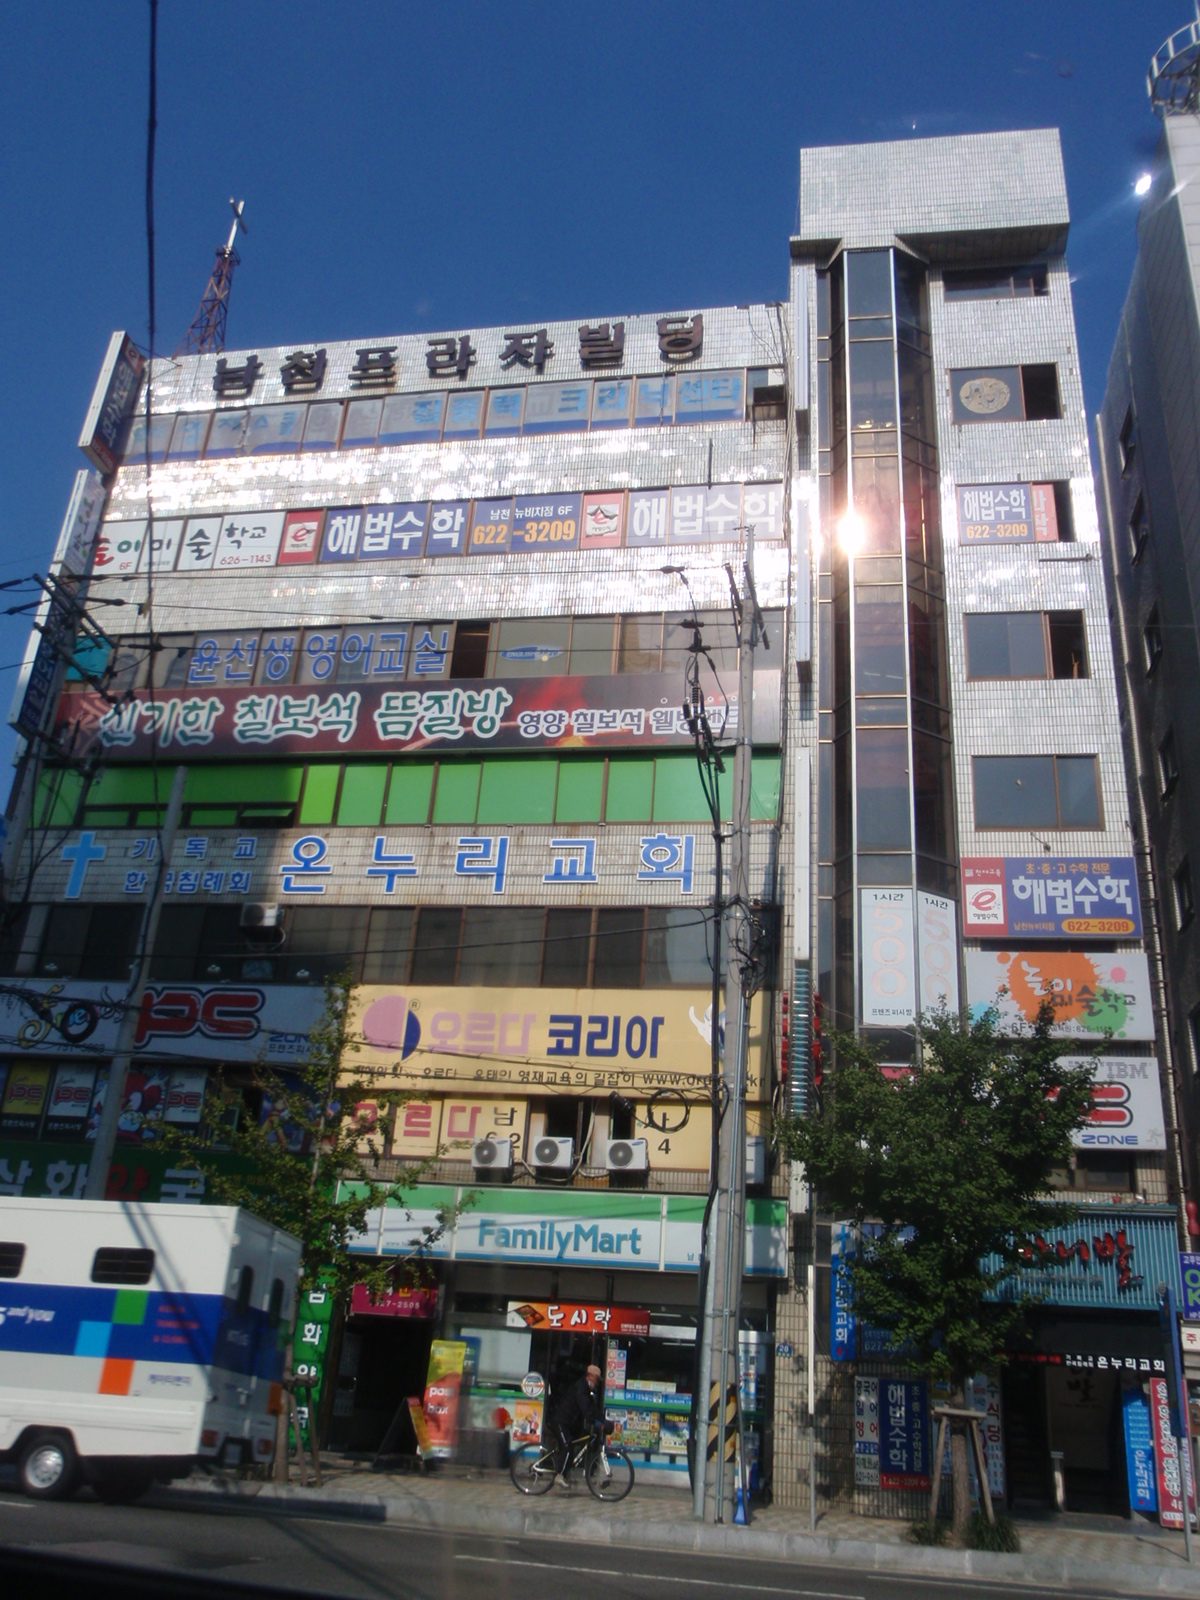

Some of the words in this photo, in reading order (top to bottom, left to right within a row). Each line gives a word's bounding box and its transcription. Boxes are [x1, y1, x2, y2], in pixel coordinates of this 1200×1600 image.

[213, 313, 704, 401] 남천프라자빌딩
[490, 508, 511, 521] 남천
[515, 505, 554, 519] 뉴비치점
[558, 505, 573, 516] 6F
[632, 491, 779, 540] 해법수학
[963, 489, 1026, 521] 해법수학
[327, 507, 465, 556] 해법수학
[473, 519, 576, 545] 622-3209
[966, 523, 1028, 539] 622-3209
[118, 561, 133, 571] 6F
[219, 553, 272, 567] 626-1143
[233, 692, 361, 743] 칠보석
[374, 687, 513, 741] 뜸질방
[518, 711, 567, 738] 영양
[571, 706, 644, 736] 칠보석
[279, 832, 696, 895] 온누리교회
[1012, 875, 1133, 915] 해법수학
[1067, 919, 1131, 932] 622-3209
[1052, 984, 1136, 1017] 미술학교
[268, 1032, 310, 1044] ZON
[430, 1012, 536, 1055] 오르다
[547, 1014, 665, 1059] 코리아
[594, 1073, 635, 1087] 길잡이
[1106, 1061, 1149, 1084] IBM
[1081, 1134, 1139, 1146] ZONE
[477, 1219, 642, 1260] FamilyMart
[546, 1304, 612, 1331] 도시락
[1097, 1355, 1166, 1372] 온누리교회
[887, 1383, 907, 1472] 해법수학
